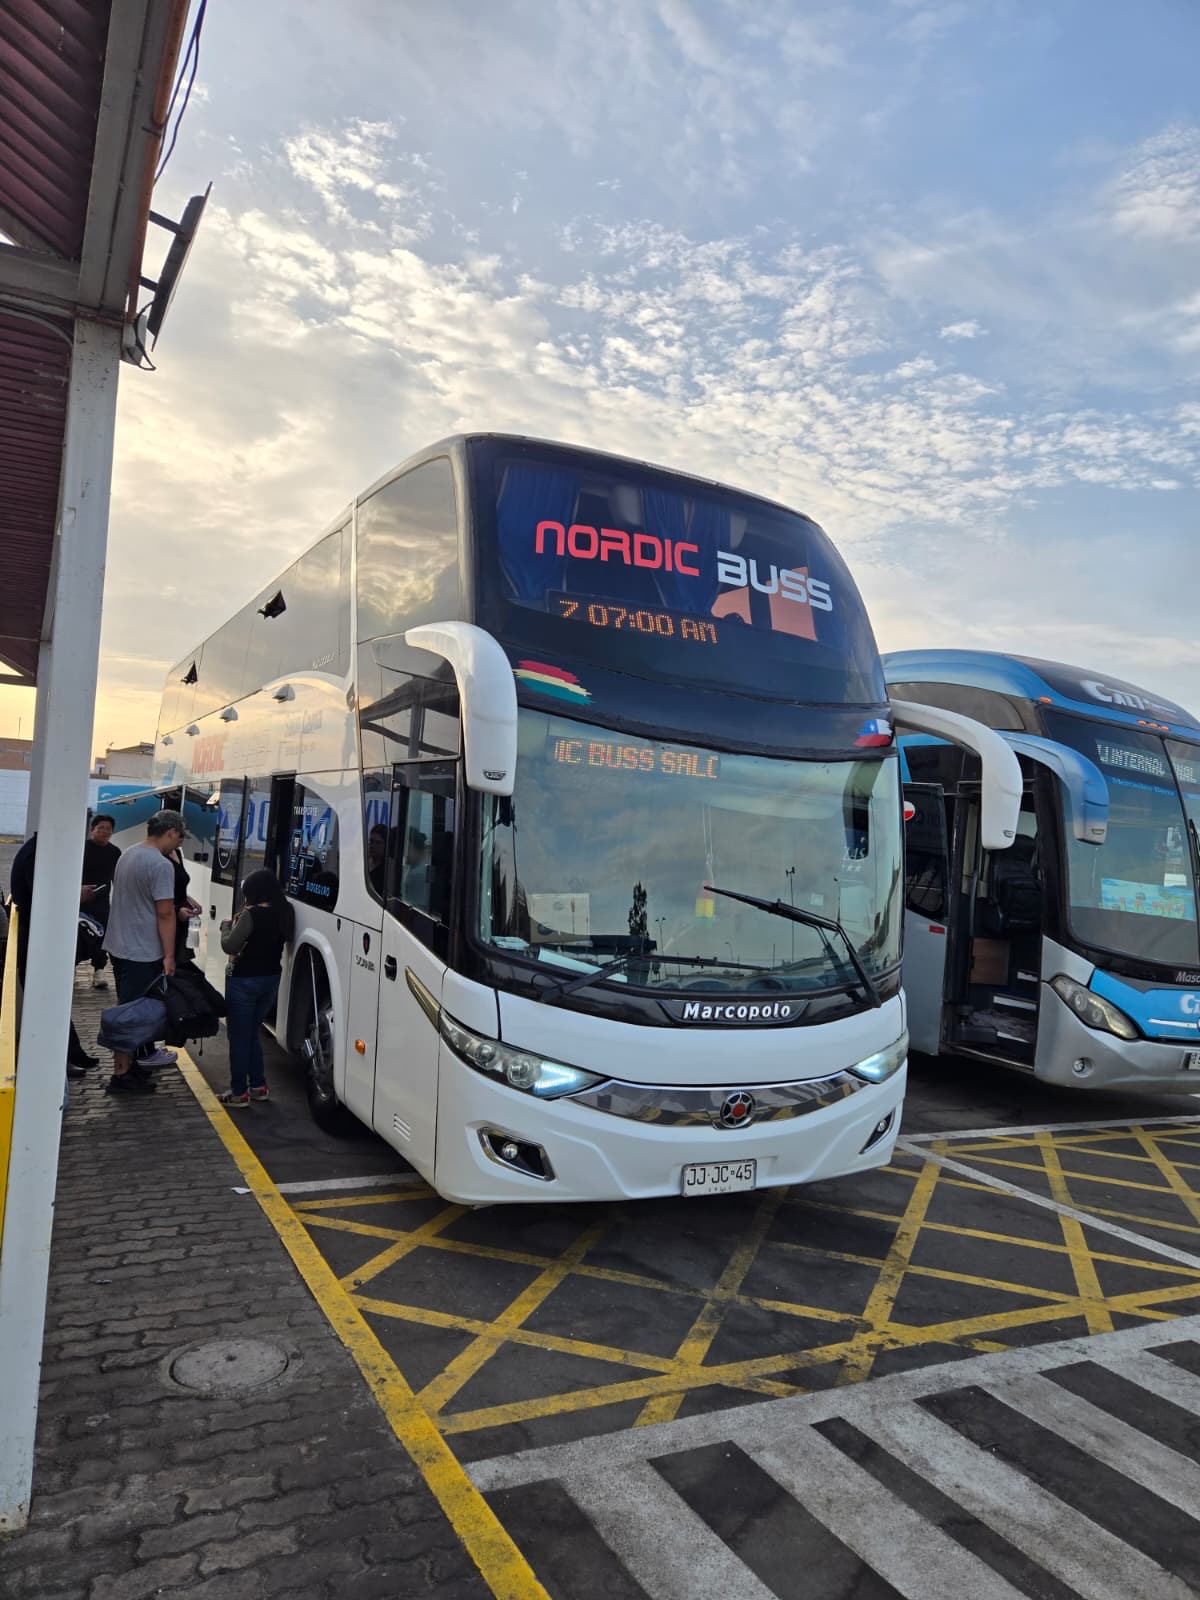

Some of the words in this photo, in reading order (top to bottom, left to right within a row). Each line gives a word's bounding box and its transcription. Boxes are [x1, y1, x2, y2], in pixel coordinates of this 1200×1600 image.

[535, 519, 700, 577] NORDIC
[716, 549, 833, 612] BUSS
[587, 603, 675, 637] 07:00
[680, 617, 718, 645] AM
[588, 742, 655, 772] BUSS
[682, 1002, 791, 1021] Marcopolo
